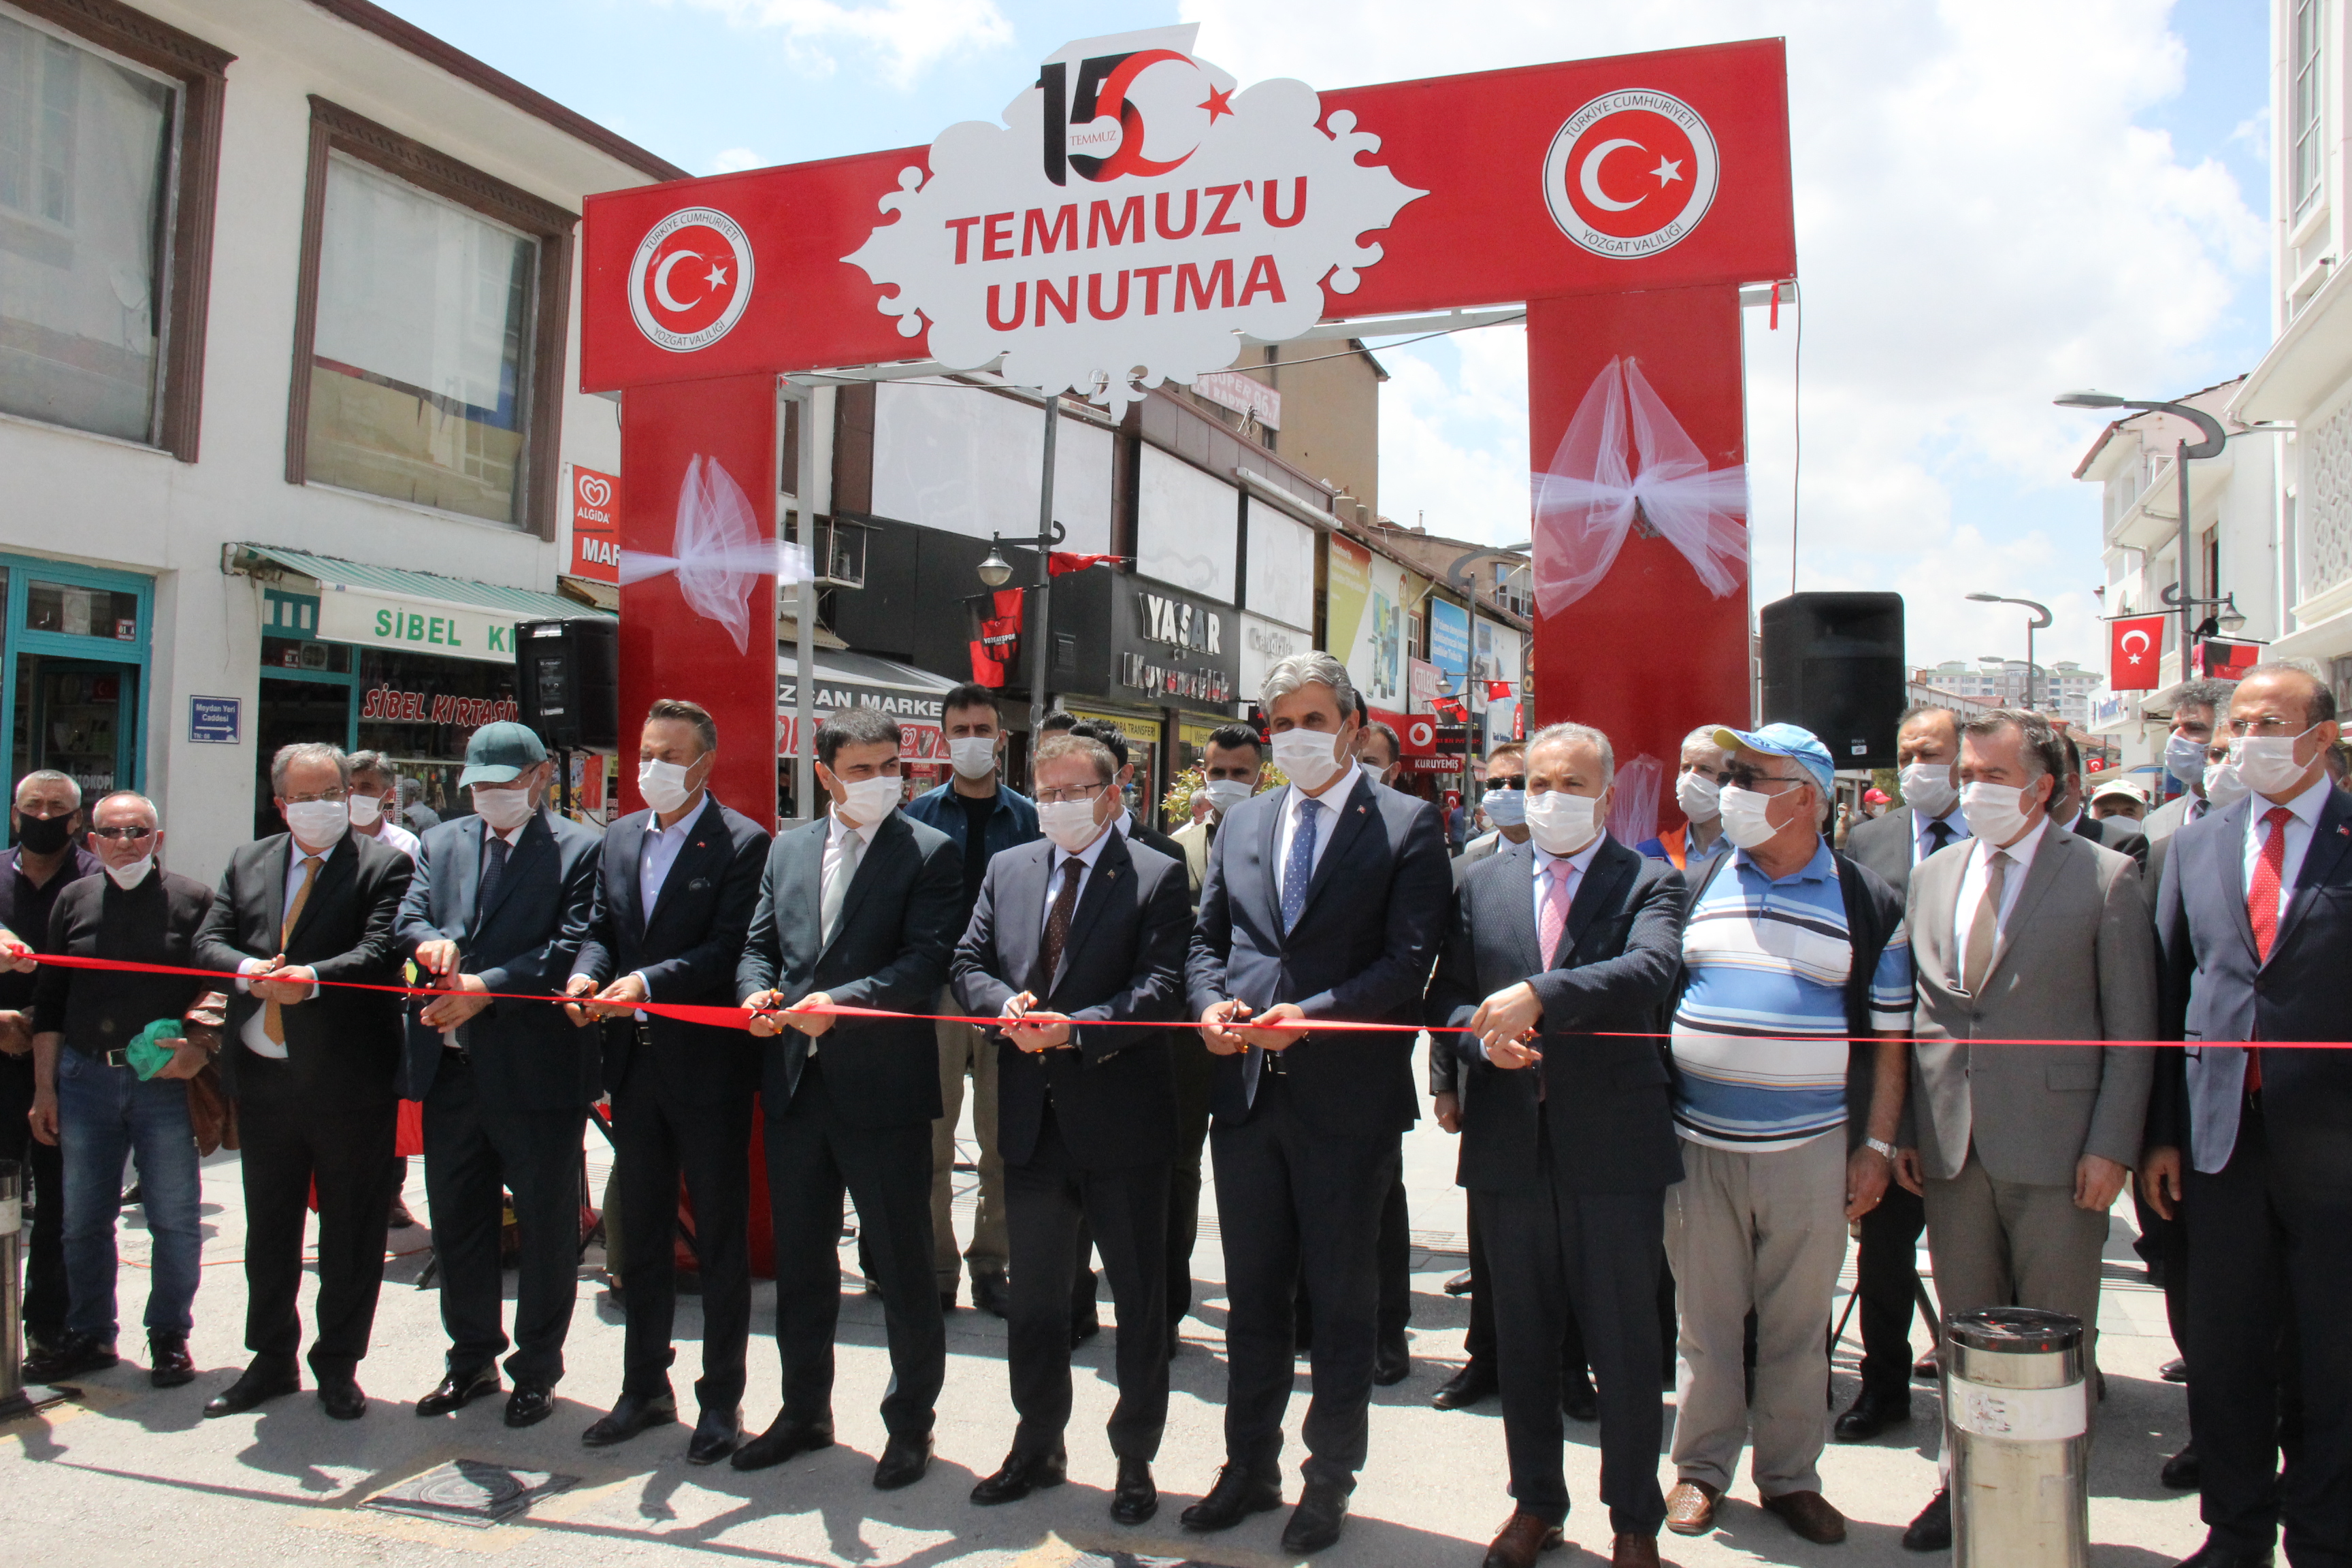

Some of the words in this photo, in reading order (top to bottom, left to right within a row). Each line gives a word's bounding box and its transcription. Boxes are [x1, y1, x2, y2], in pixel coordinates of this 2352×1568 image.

[1034, 49, 1145, 187] 15
[1564, 101, 1612, 138] TÜRKİYE
[1613, 95, 1698, 131] CUMHURİYETİ
[1069, 130, 1117, 146] TEMMUZ
[644, 218, 679, 250] TÜRKİYE
[680, 212, 740, 242] CUMHURİYETİ
[945, 176, 1307, 265] TEMMUZ'U
[1582, 229, 1631, 252] YOZGAT
[1632, 221, 1684, 252] VALİLİĞİ
[986, 254, 1287, 332] UNUTMA
[654, 327, 689, 346] YOZGAT
[689, 319, 726, 346] VALİLİĞİ
[375, 607, 462, 647] SİBEL
[983, 633, 1016, 644] YOZGATSPOR
[195, 703, 222, 713] Meydan
[223, 705, 236, 713] Yeri
[362, 682, 426, 722] SİBEL
[778, 683, 852, 708] ZAN
[201, 713, 229, 722] Caddesi
[1128, 723, 1156, 737] TRANSFERİ
